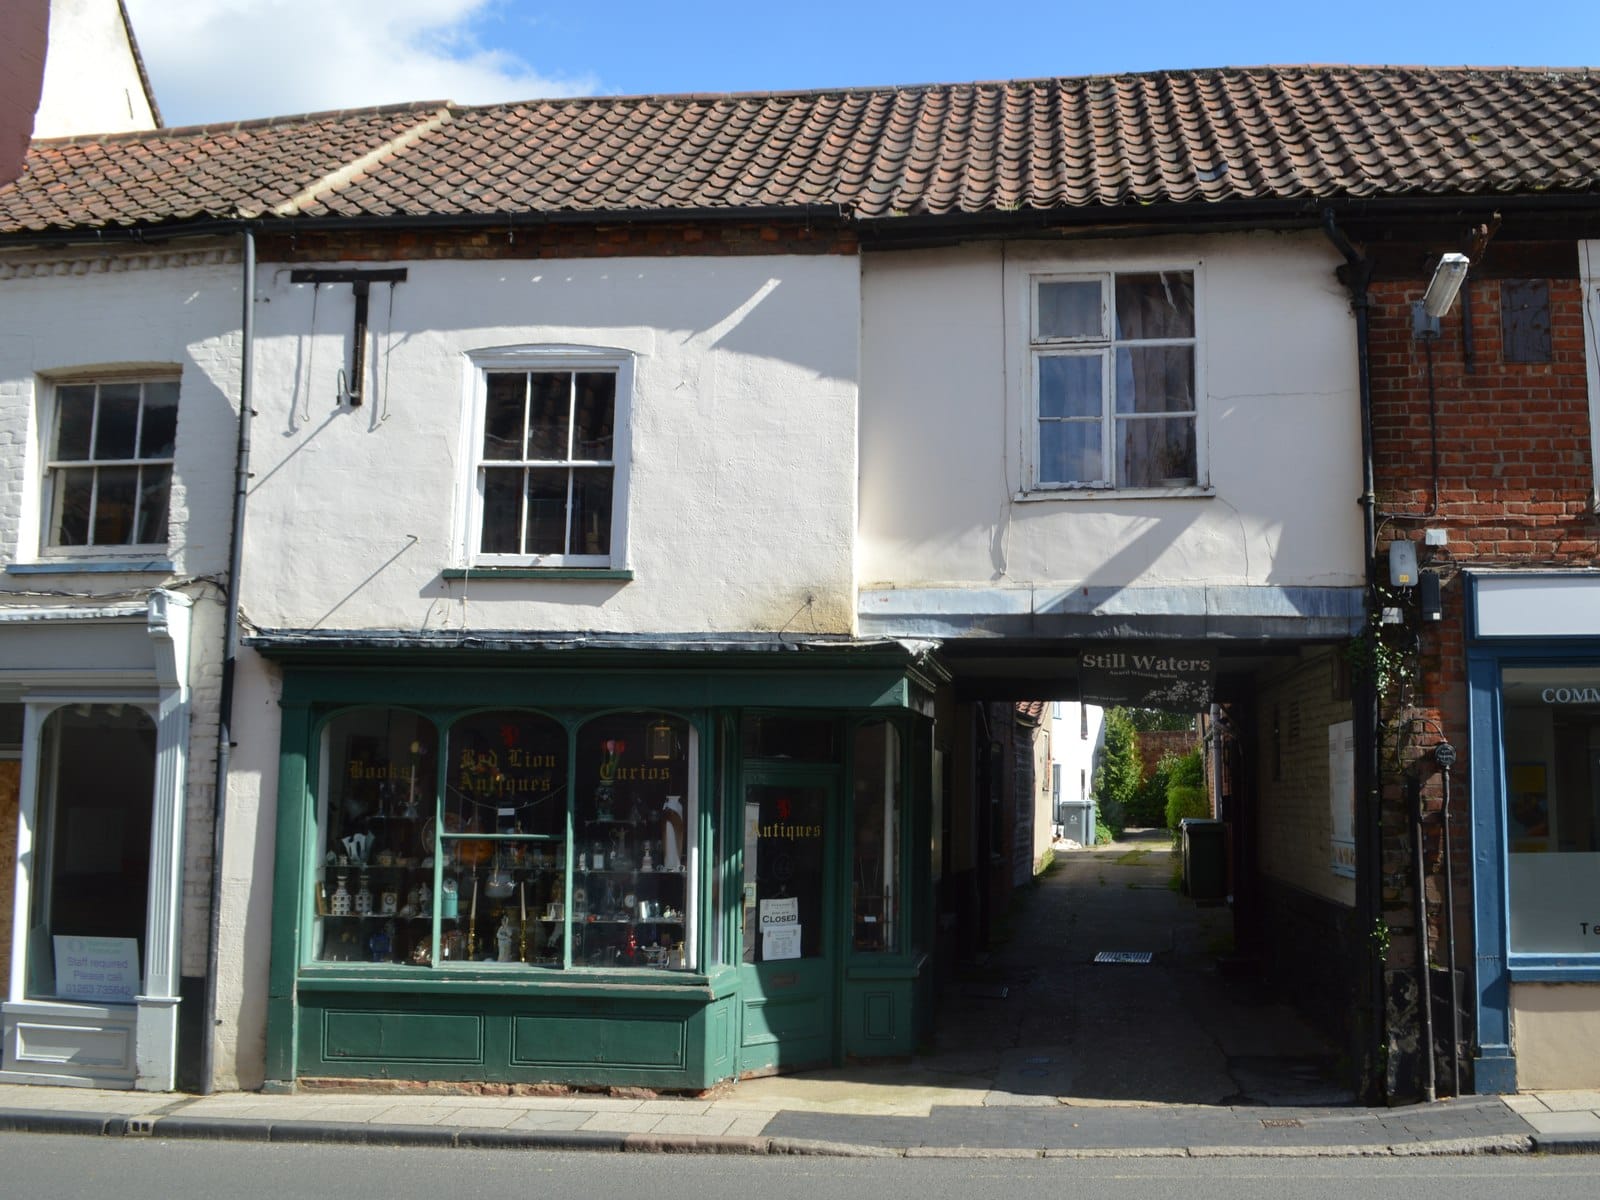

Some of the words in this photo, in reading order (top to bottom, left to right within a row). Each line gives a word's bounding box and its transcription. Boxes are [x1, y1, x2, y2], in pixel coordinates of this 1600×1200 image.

[1083, 653, 1126, 668] Still
[1131, 655, 1211, 672] Waters
[460, 747, 497, 771] Red
[508, 748, 557, 769] Lion
[348, 758, 415, 782] Books
[599, 761, 671, 781] Curios
[460, 773, 552, 796] Antiques
[751, 821, 822, 840] Antiques
[762, 915, 798, 923] CLOSED
[68, 956, 88, 967] Staff
[90, 958, 129, 969] required
